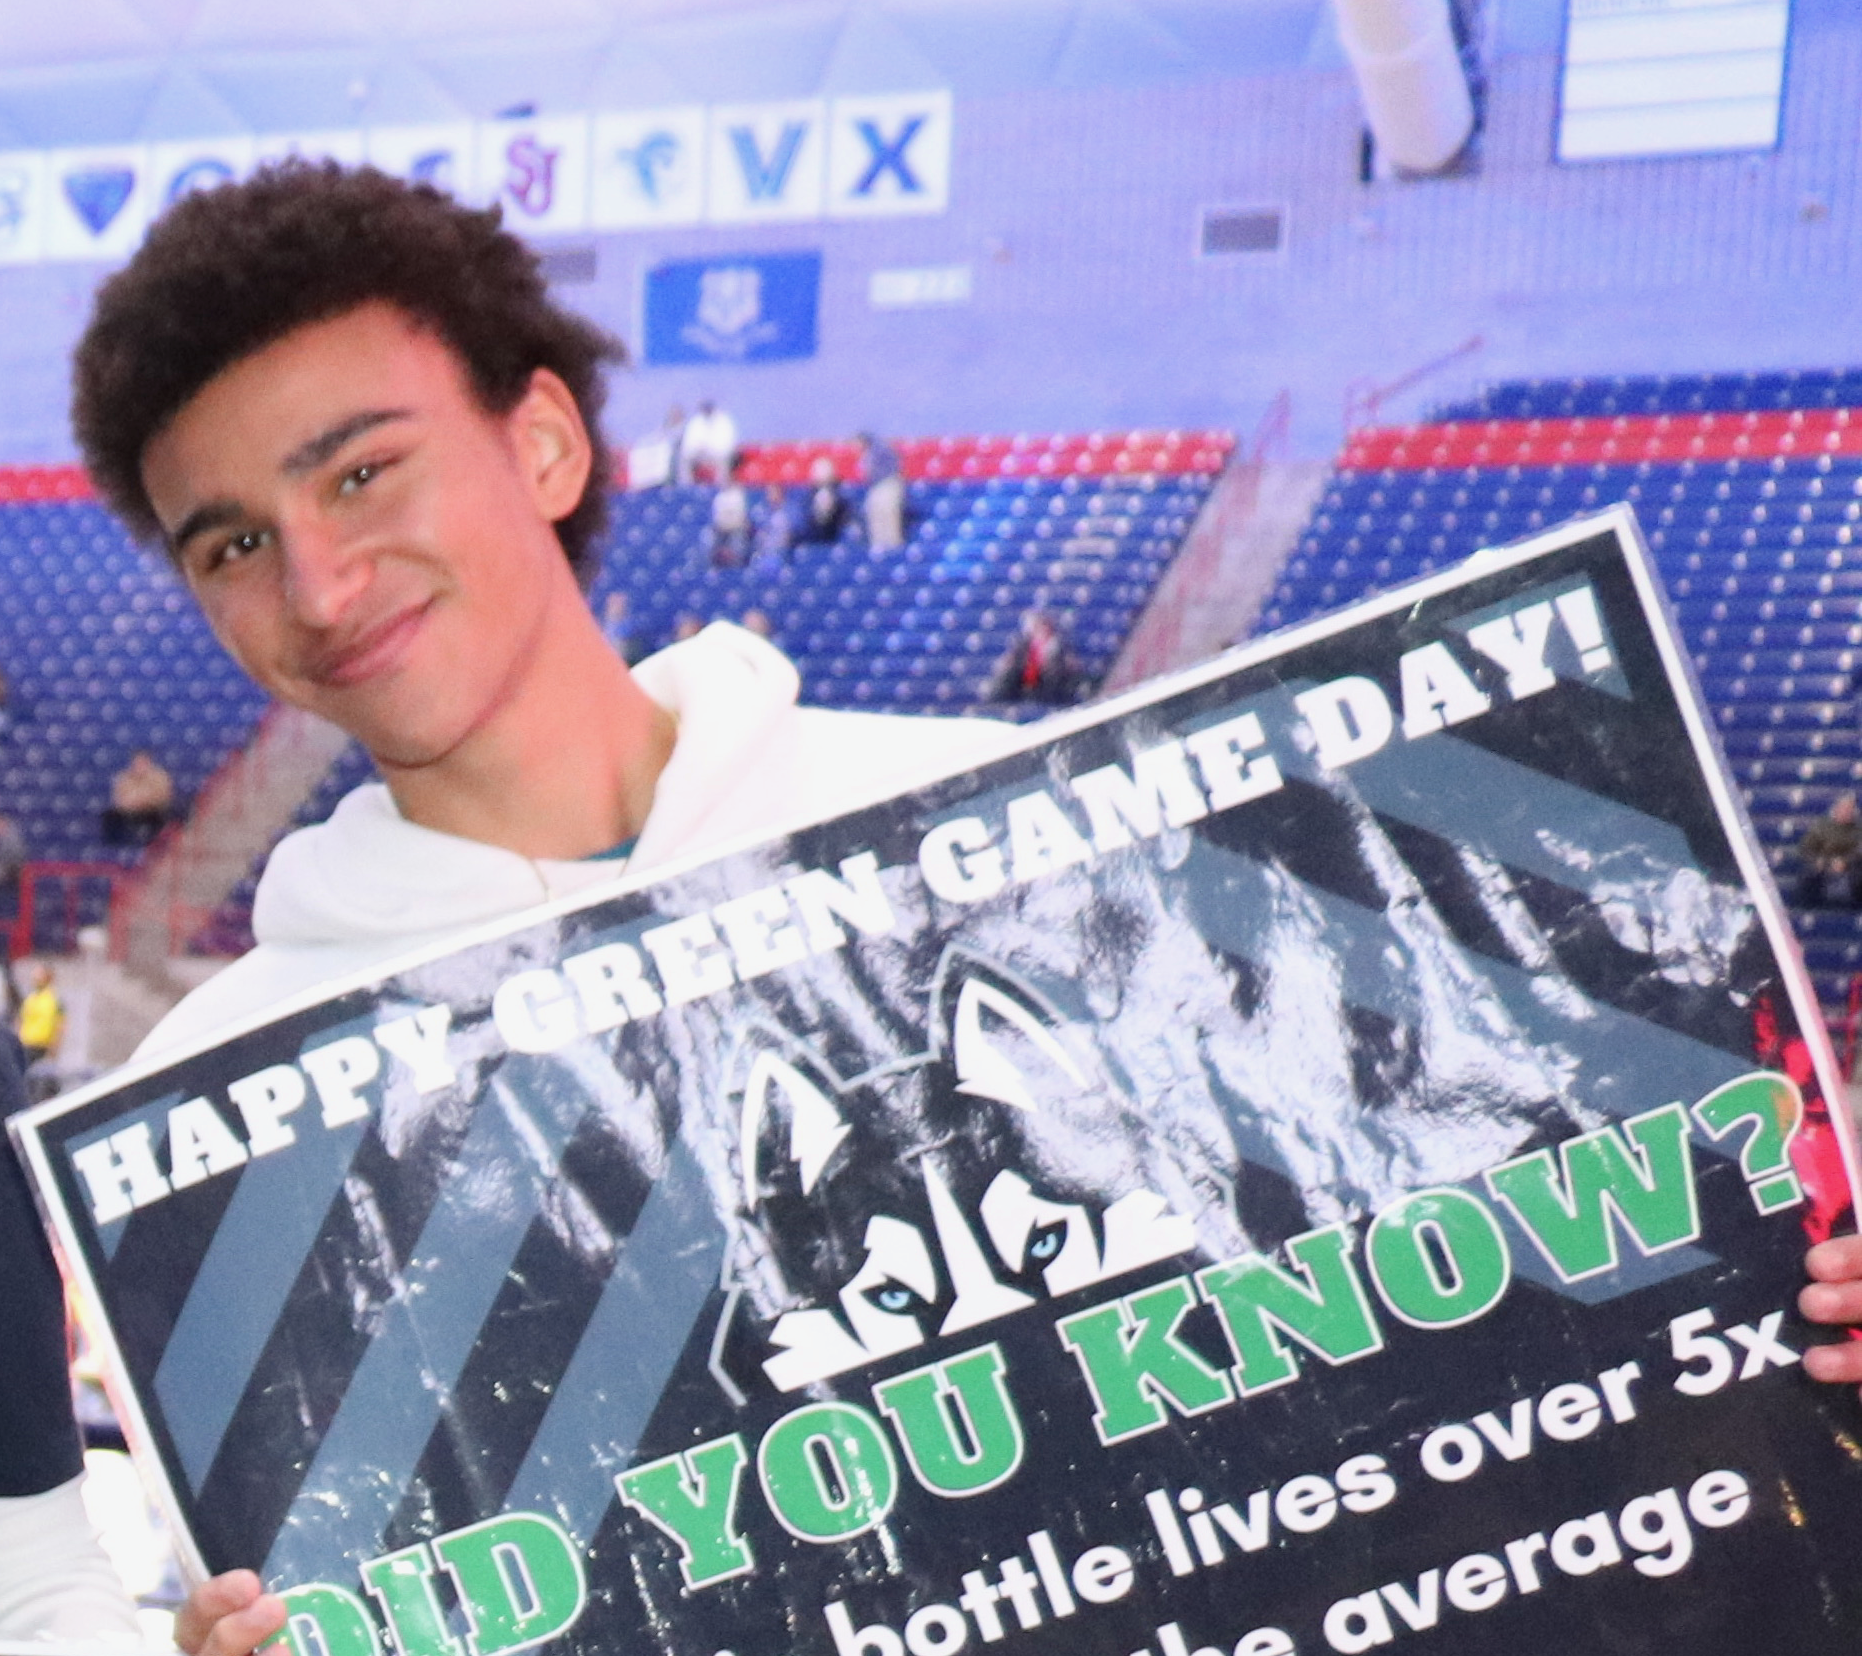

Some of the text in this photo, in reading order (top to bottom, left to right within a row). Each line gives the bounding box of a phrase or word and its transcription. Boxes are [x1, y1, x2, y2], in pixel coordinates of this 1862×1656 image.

[846, 113, 926, 198] X
[71, 585, 1615, 1226] HAPPY GREEN GAME DAY!
[616, 1341, 1025, 1592] YOU
[1057, 1070, 1804, 1447] KNOW?
[1145, 1453, 1397, 1577] lives
[1420, 1359, 1644, 1484] over
[1671, 1307, 1802, 1397] 5x
[1323, 1470, 1753, 1656] average
